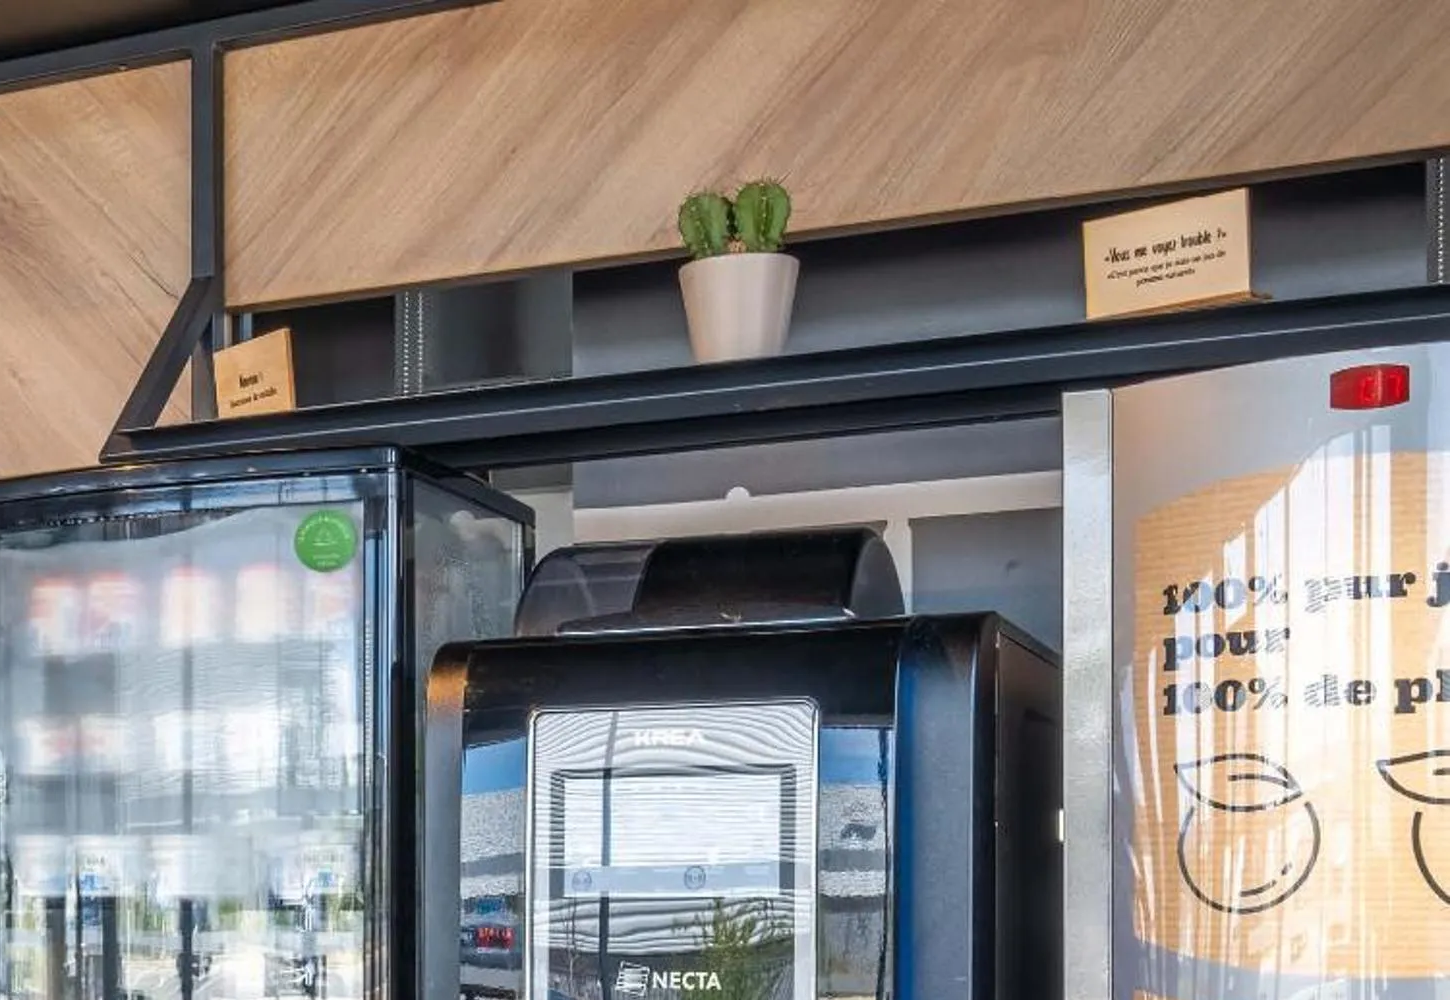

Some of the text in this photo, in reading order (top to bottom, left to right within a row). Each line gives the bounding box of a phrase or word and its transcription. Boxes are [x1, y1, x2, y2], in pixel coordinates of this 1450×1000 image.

[1163, 573, 1289, 615] 100%
[1163, 627, 1290, 672] pour
[1163, 676, 1289, 716] 100%
[652, 971, 723, 991] NECTA
